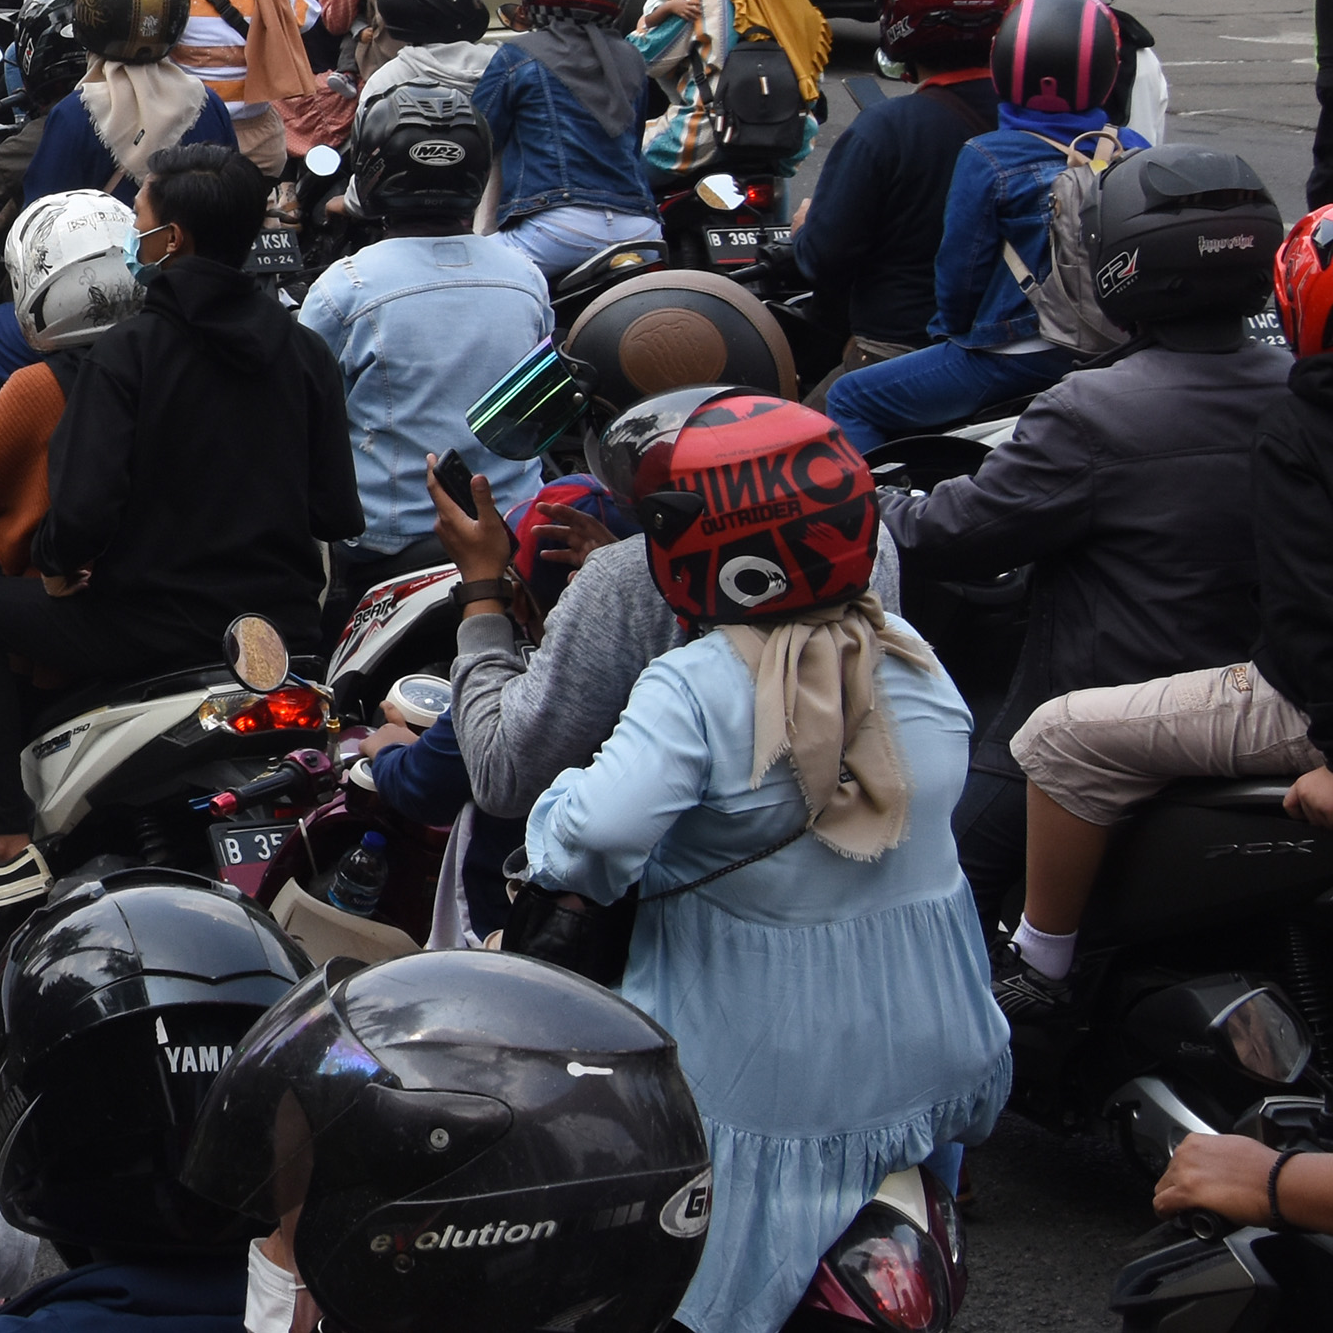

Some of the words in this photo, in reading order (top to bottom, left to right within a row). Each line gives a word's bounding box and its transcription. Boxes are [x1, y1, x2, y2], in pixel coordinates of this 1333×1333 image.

[416, 146, 460, 158] MAZ
[261, 233, 291, 249] KSK
[711, 233, 722, 246] B
[728, 232, 759, 246] 396
[700, 499, 803, 536] OUTRIDER
[71, 722, 91, 735] 150
[224, 837, 243, 865] B
[164, 1045, 236, 1073] YAMA
[370, 1217, 558, 1254] evolution
